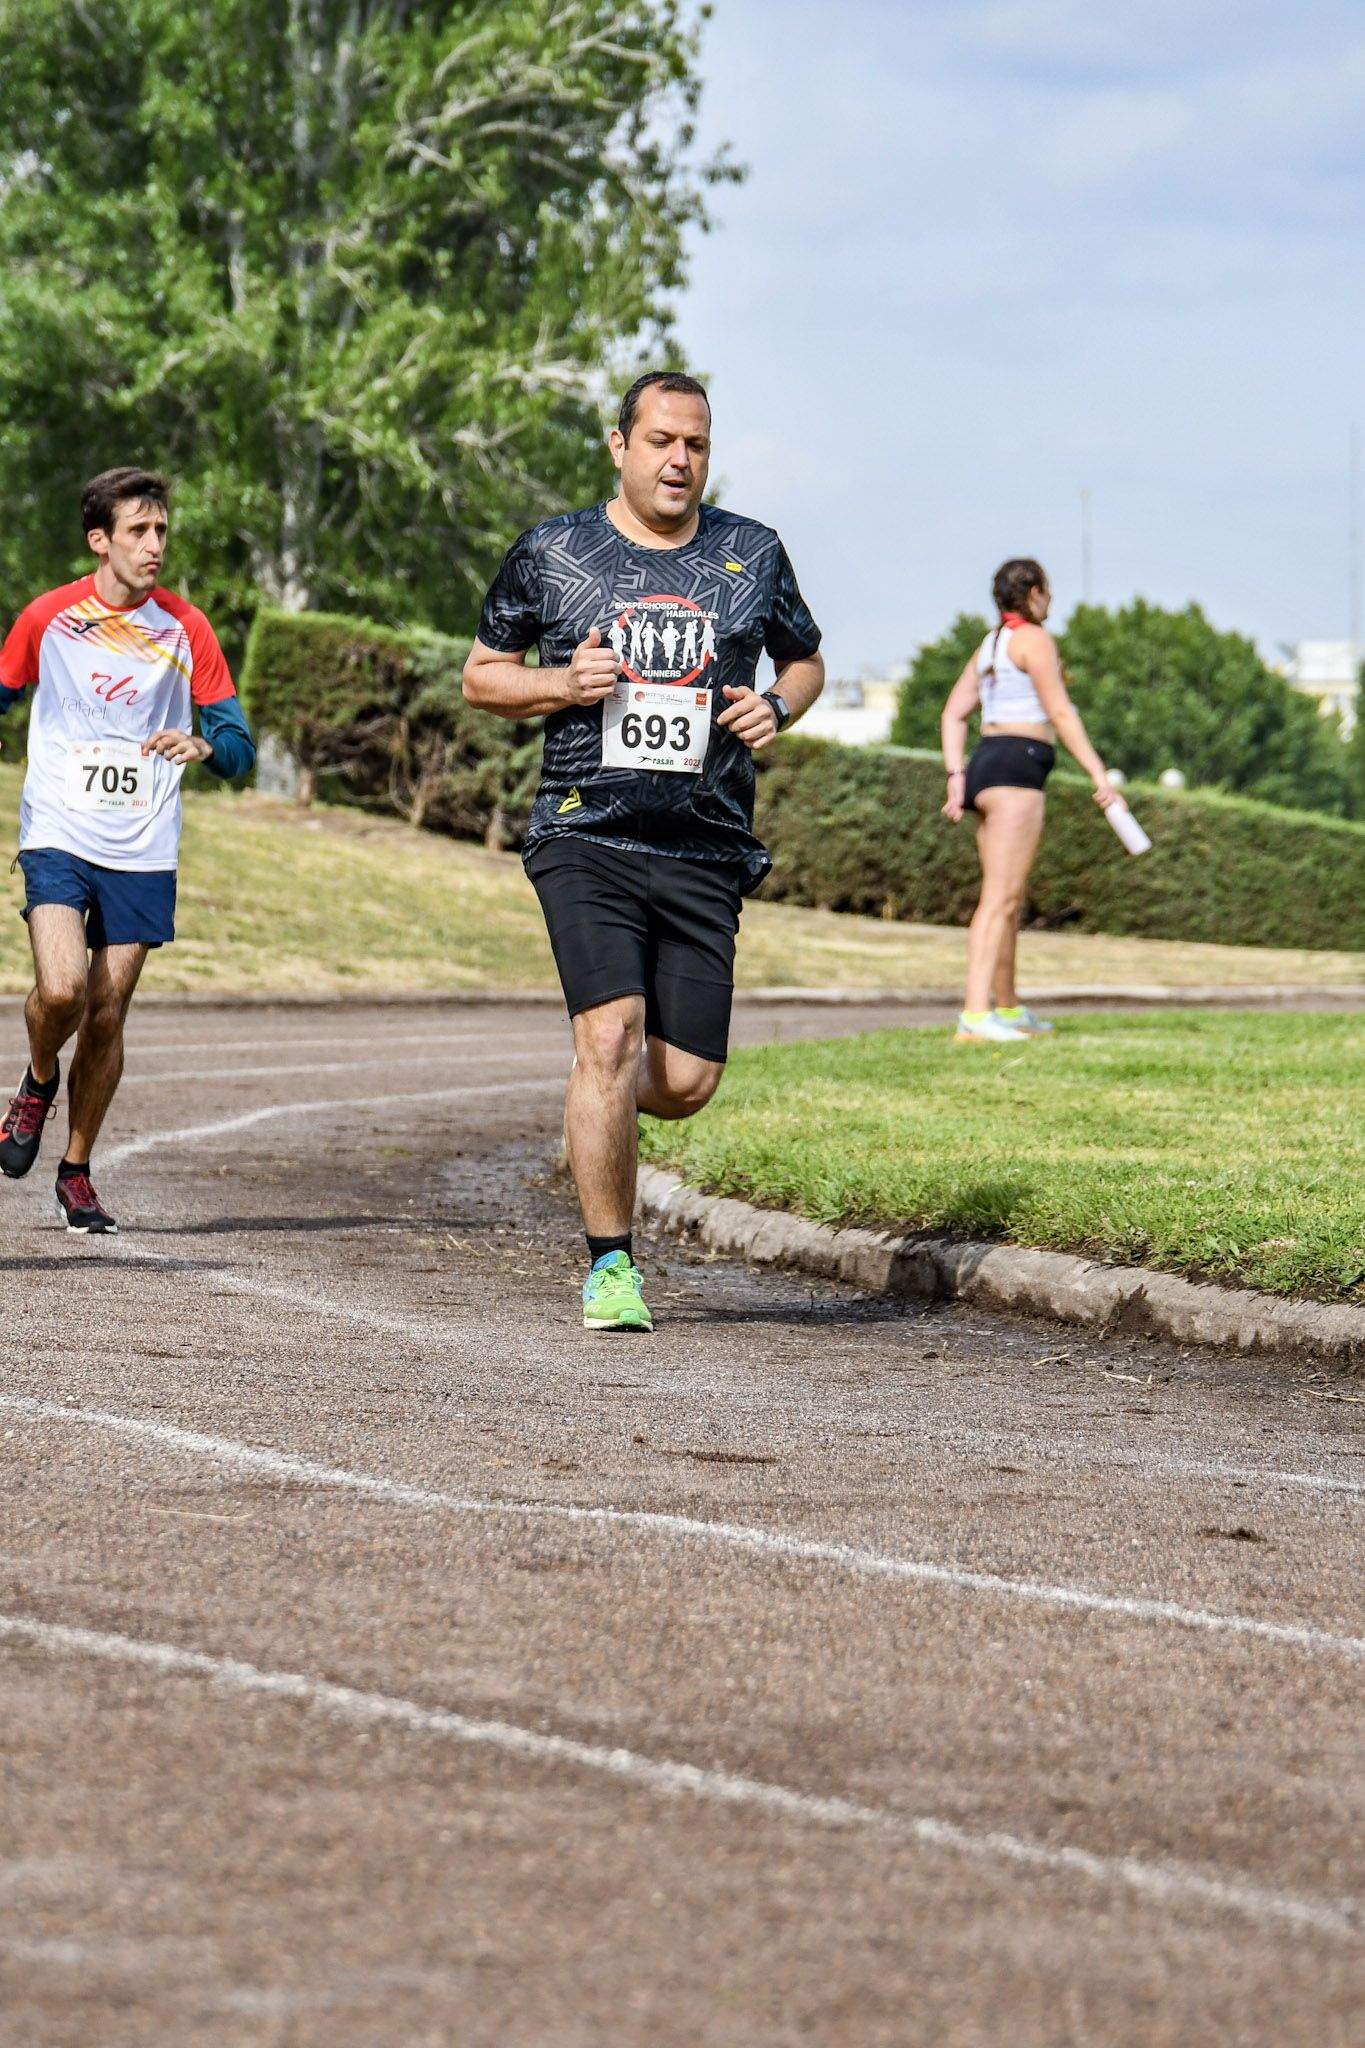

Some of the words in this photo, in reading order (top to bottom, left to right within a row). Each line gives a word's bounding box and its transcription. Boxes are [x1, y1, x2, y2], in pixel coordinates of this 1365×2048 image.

[614, 601, 679, 611] SOSPECHOSOS
[665, 609, 720, 620] HABITUALES
[641, 669, 682, 678] RUNNERS
[621, 712, 692, 752] 693
[82, 765, 138, 794] 705
